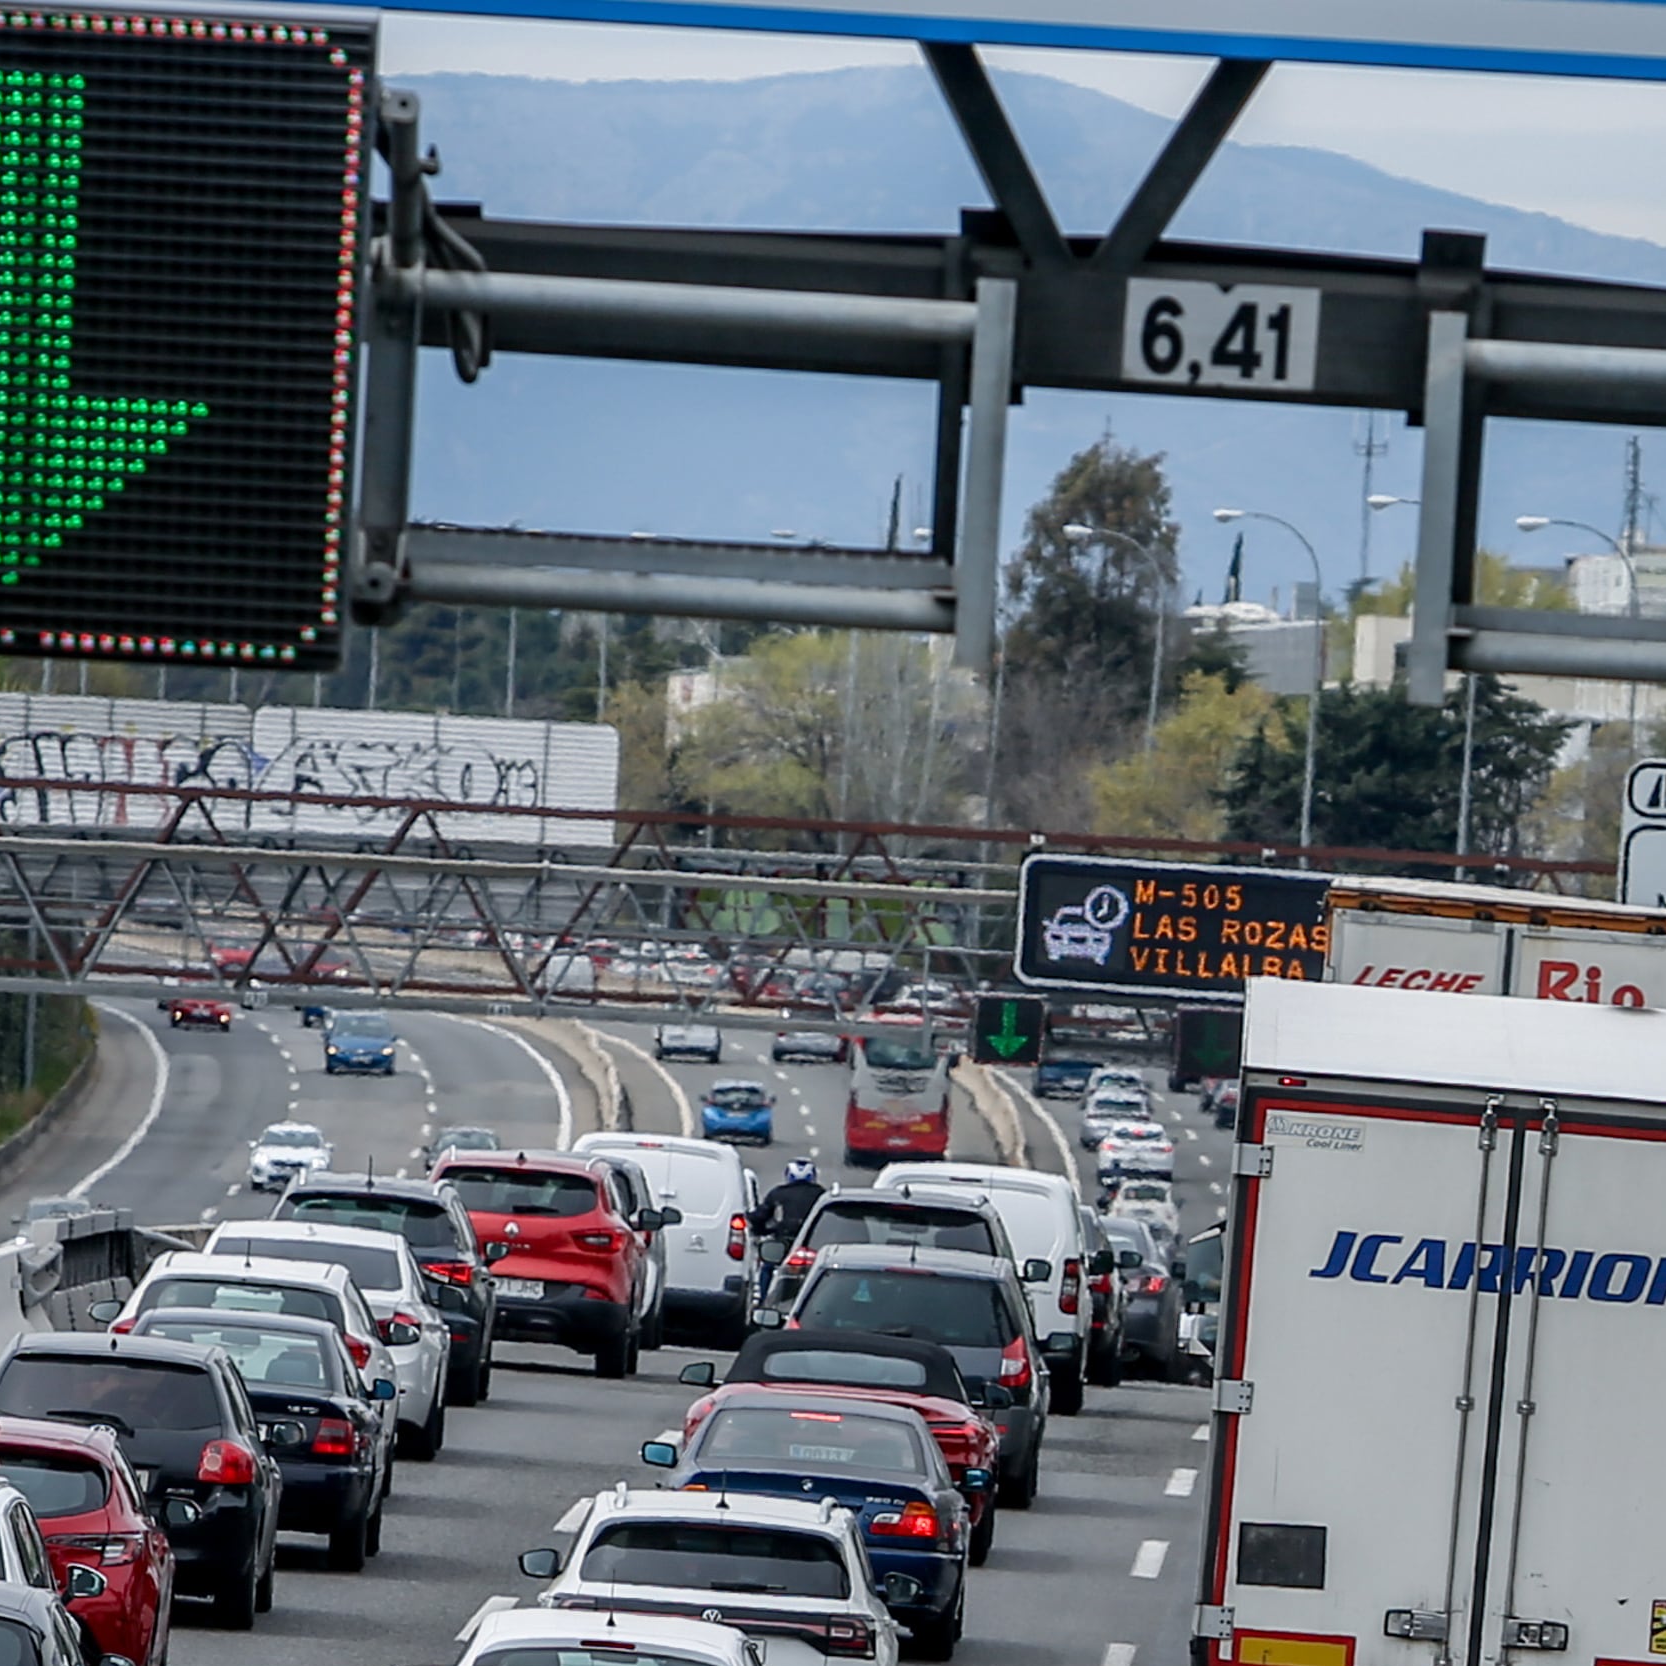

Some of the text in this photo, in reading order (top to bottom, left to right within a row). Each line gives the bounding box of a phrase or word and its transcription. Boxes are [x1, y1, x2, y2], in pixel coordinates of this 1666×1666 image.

[1141, 296, 1291, 383] 6,41
[1134, 879, 1244, 911] M-505
[1133, 912, 1331, 953] LAS ROZAS
[1352, 965, 1485, 993] LECHE
[1290, 1122, 1361, 1141] KRONE
[1306, 1138, 1363, 1151] Cool Liner
